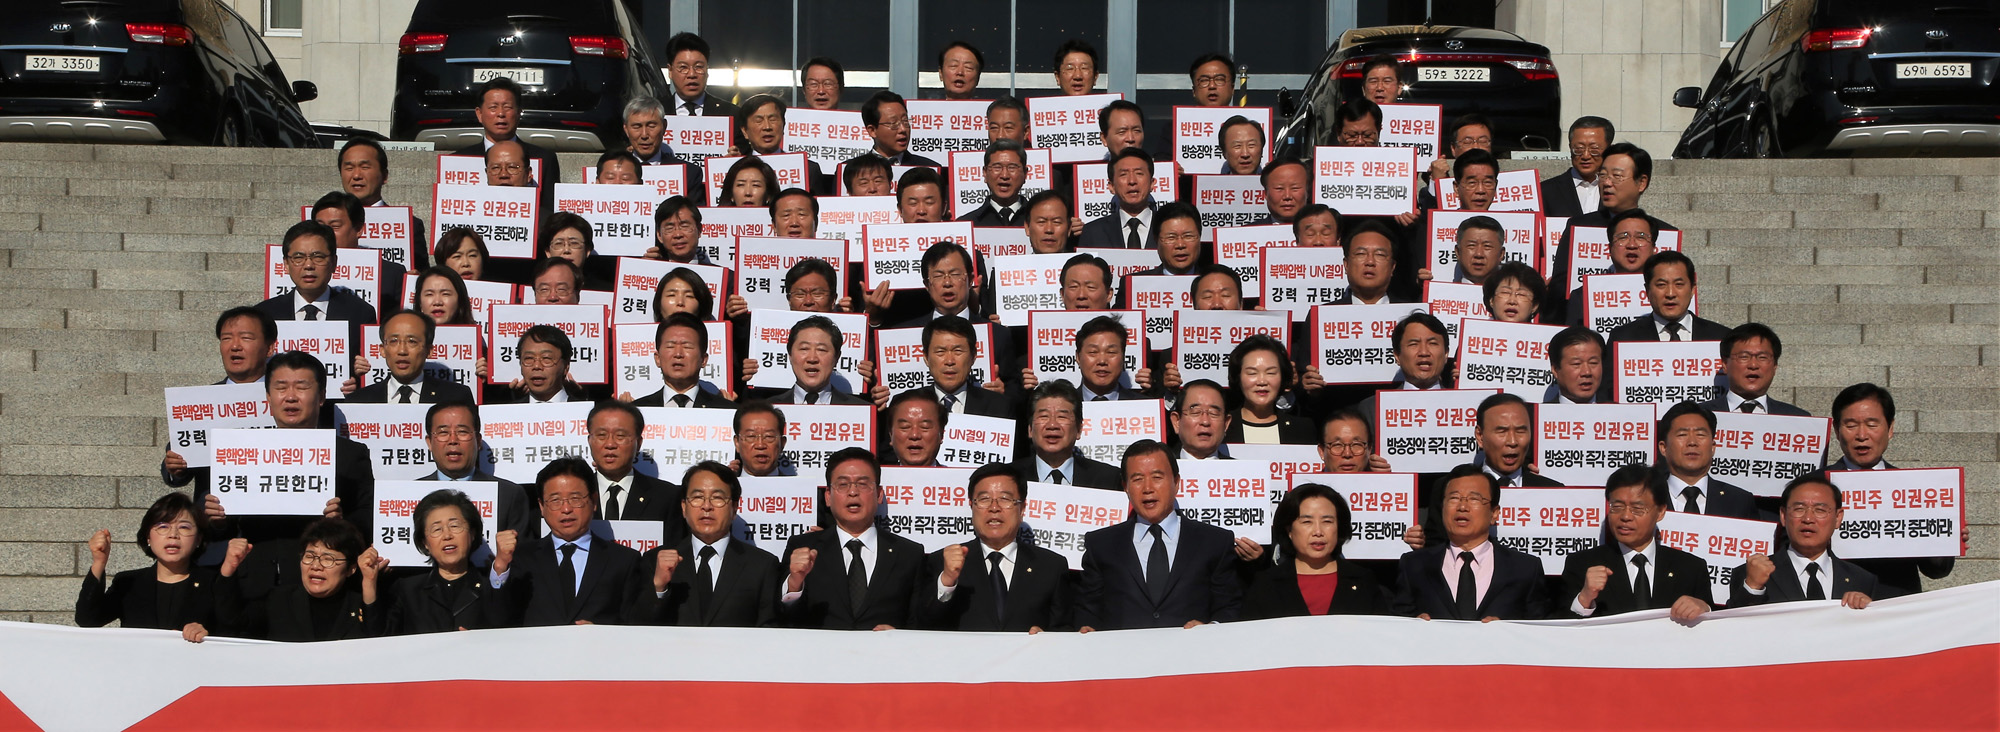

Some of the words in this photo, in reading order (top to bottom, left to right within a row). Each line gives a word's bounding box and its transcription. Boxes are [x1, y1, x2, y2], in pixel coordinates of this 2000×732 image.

[32, 57, 56, 69] 32가
[61, 57, 93, 70] 3350
[1904, 65, 1927, 77] 69하
[1933, 65, 1965, 77] 6593
[508, 71, 535, 82] 7111
[1425, 69, 1447, 80] 59호
[1454, 69, 1483, 80] 3222
[911, 115, 943, 130] 반민주
[1034, 111, 1067, 126] 반민주
[788, 122, 820, 137] 반민주
[1181, 122, 1213, 137] 반민주
[1390, 119, 1435, 135] 인권유린
[681, 130, 725, 145] 인권유린
[912, 138, 943, 151] 방송장악
[944, 139, 960, 151] 즉각
[1037, 134, 1067, 148] 방송장악
[1069, 132, 1085, 146] 즉각
[788, 144, 819, 158] 방송장악
[821, 147, 837, 160] 즉각
[1182, 145, 1213, 159] 방송장악
[1320, 161, 1354, 176] 반민주
[1362, 162, 1409, 178] 인권유린
[445, 171, 480, 185] 반민주
[1201, 189, 1235, 205] 반민주
[1321, 184, 1353, 200] 방송장악
[1355, 185, 1372, 199] 즉각
[1374, 185, 1407, 200] 중단하라!
[441, 199, 476, 213] 반민주
[483, 201, 531, 218] 인권유린
[558, 200, 594, 214] 북핵압박
[597, 200, 629, 215] UN결의
[634, 200, 652, 215] 기권
[1084, 202, 1116, 218] 방송장악
[821, 211, 855, 225] 북핵압박
[858, 211, 890, 224] UN결의
[1202, 213, 1234, 227] 방송장악
[475, 224, 492, 241] 즉각
[494, 225, 528, 242] 중단하라!
[594, 222, 649, 238] 규탄한다!
[731, 224, 763, 236] UN결의
[1512, 229, 1530, 245] 기권
[872, 237, 910, 252] 반민주
[1222, 242, 1258, 259] 반민주
[696, 246, 719, 260] 강력
[744, 254, 780, 269] 북핵압박
[874, 260, 909, 275] 방송장악
[355, 265, 374, 281] 기권
[1000, 270, 1037, 285] 반민주
[1270, 264, 1306, 279] 북핵압박
[1310, 264, 1344, 279] UN결의
[745, 278, 770, 294] 강력
[1003, 295, 1038, 310] 방송장악
[1040, 295, 1057, 308] 즉각
[1136, 292, 1173, 309] 반민주
[1272, 287, 1297, 303] 강력
[1593, 291, 1631, 308] 반민주
[622, 297, 647, 315] 강력
[1432, 299, 1468, 317] 북핵압박
[498, 322, 534, 338] 북핵압
[580, 322, 599, 338] 기권
[1038, 328, 1076, 346] 반민주
[1183, 326, 1222, 344] 반민주
[1323, 321, 1363, 339] 반민주
[283, 339, 319, 354] UN결의
[324, 338, 344, 354] 기권
[842, 332, 861, 348] 기권
[1467, 336, 1508, 357] 반민주
[453, 344, 472, 360] 기권
[885, 345, 924, 363] 반민주
[1325, 348, 1363, 366] 방송장악
[1365, 348, 1383, 365] 즉각
[762, 352, 788, 369] 강력
[1039, 355, 1076, 372] 방송장악
[1184, 353, 1221, 370] 방송장악
[1624, 358, 1664, 376] 반민주
[624, 365, 651, 380] 강력
[888, 371, 924, 390] 방송장악
[1467, 363, 1504, 383] 방송장악
[1506, 366, 1526, 384] 즉각
[1626, 386, 1663, 402] 방송장악
[1665, 387, 1684, 402] 즉각
[172, 404, 214, 421] 북핵압박
[217, 402, 257, 418] UN결의
[1385, 408, 1427, 427] 반민주
[340, 423, 380, 439] 북핵압박
[384, 423, 422, 438] UN결의
[484, 421, 524, 439] 북핵압박
[527, 420, 565, 436] UN결의
[670, 425, 706, 439] UN결의
[711, 425, 732, 442] 기권
[810, 423, 865, 441] 인권유린
[1100, 417, 1155, 435] 인권유린
[1543, 421, 1585, 440] 반민주
[1593, 421, 1649, 440] 인권유린
[177, 431, 206, 447] 강력
[949, 428, 986, 444] UN결의
[990, 431, 1010, 448] 기권
[1386, 437, 1426, 455] 방송장악
[1428, 437, 1448, 454] 즉각
[1713, 430, 1754, 449] 반민주
[1763, 432, 1821, 454] 인권유린
[216, 448, 258, 465] 북핵압박
[262, 448, 303, 465] UN결의
[308, 448, 331, 465] 기권
[487, 448, 514, 464] 강력
[525, 444, 589, 463] 규탄한다!
[665, 449, 729, 465] 규탄한다!
[802, 452, 822, 468] 즉각
[1094, 445, 1114, 461] 즉각
[1544, 450, 1583, 468] 방송장악
[1585, 451, 1605, 468] 즉각
[1607, 450, 1647, 468] 중단하라!
[1710, 458, 1749, 477] 방송장악
[1752, 460, 1772, 478] 즉각
[218, 476, 248, 492] 강력
[259, 475, 328, 493] 규탄한다!
[1208, 478, 1265, 498] 인권유린
[747, 498, 787, 514] UN결의
[791, 497, 813, 514] 기권
[1350, 492, 1408, 512] 인권유린
[1891, 488, 1954, 509] 인권유린
[1201, 509, 1221, 526] 즉각
[1223, 508, 1264, 526] 중단하라!
[1540, 507, 1599, 527] 인권유린
[914, 517, 935, 534] 즉각
[1365, 522, 1407, 540] 중단하라!
[1839, 521, 1881, 539] 방송장악
[1884, 520, 1905, 538] 즉각
[1908, 519, 1953, 538] 중단하라!
[381, 527, 410, 543] 강력
[1054, 531, 1076, 549] 즉각
[1531, 538, 1553, 556] 즉각
